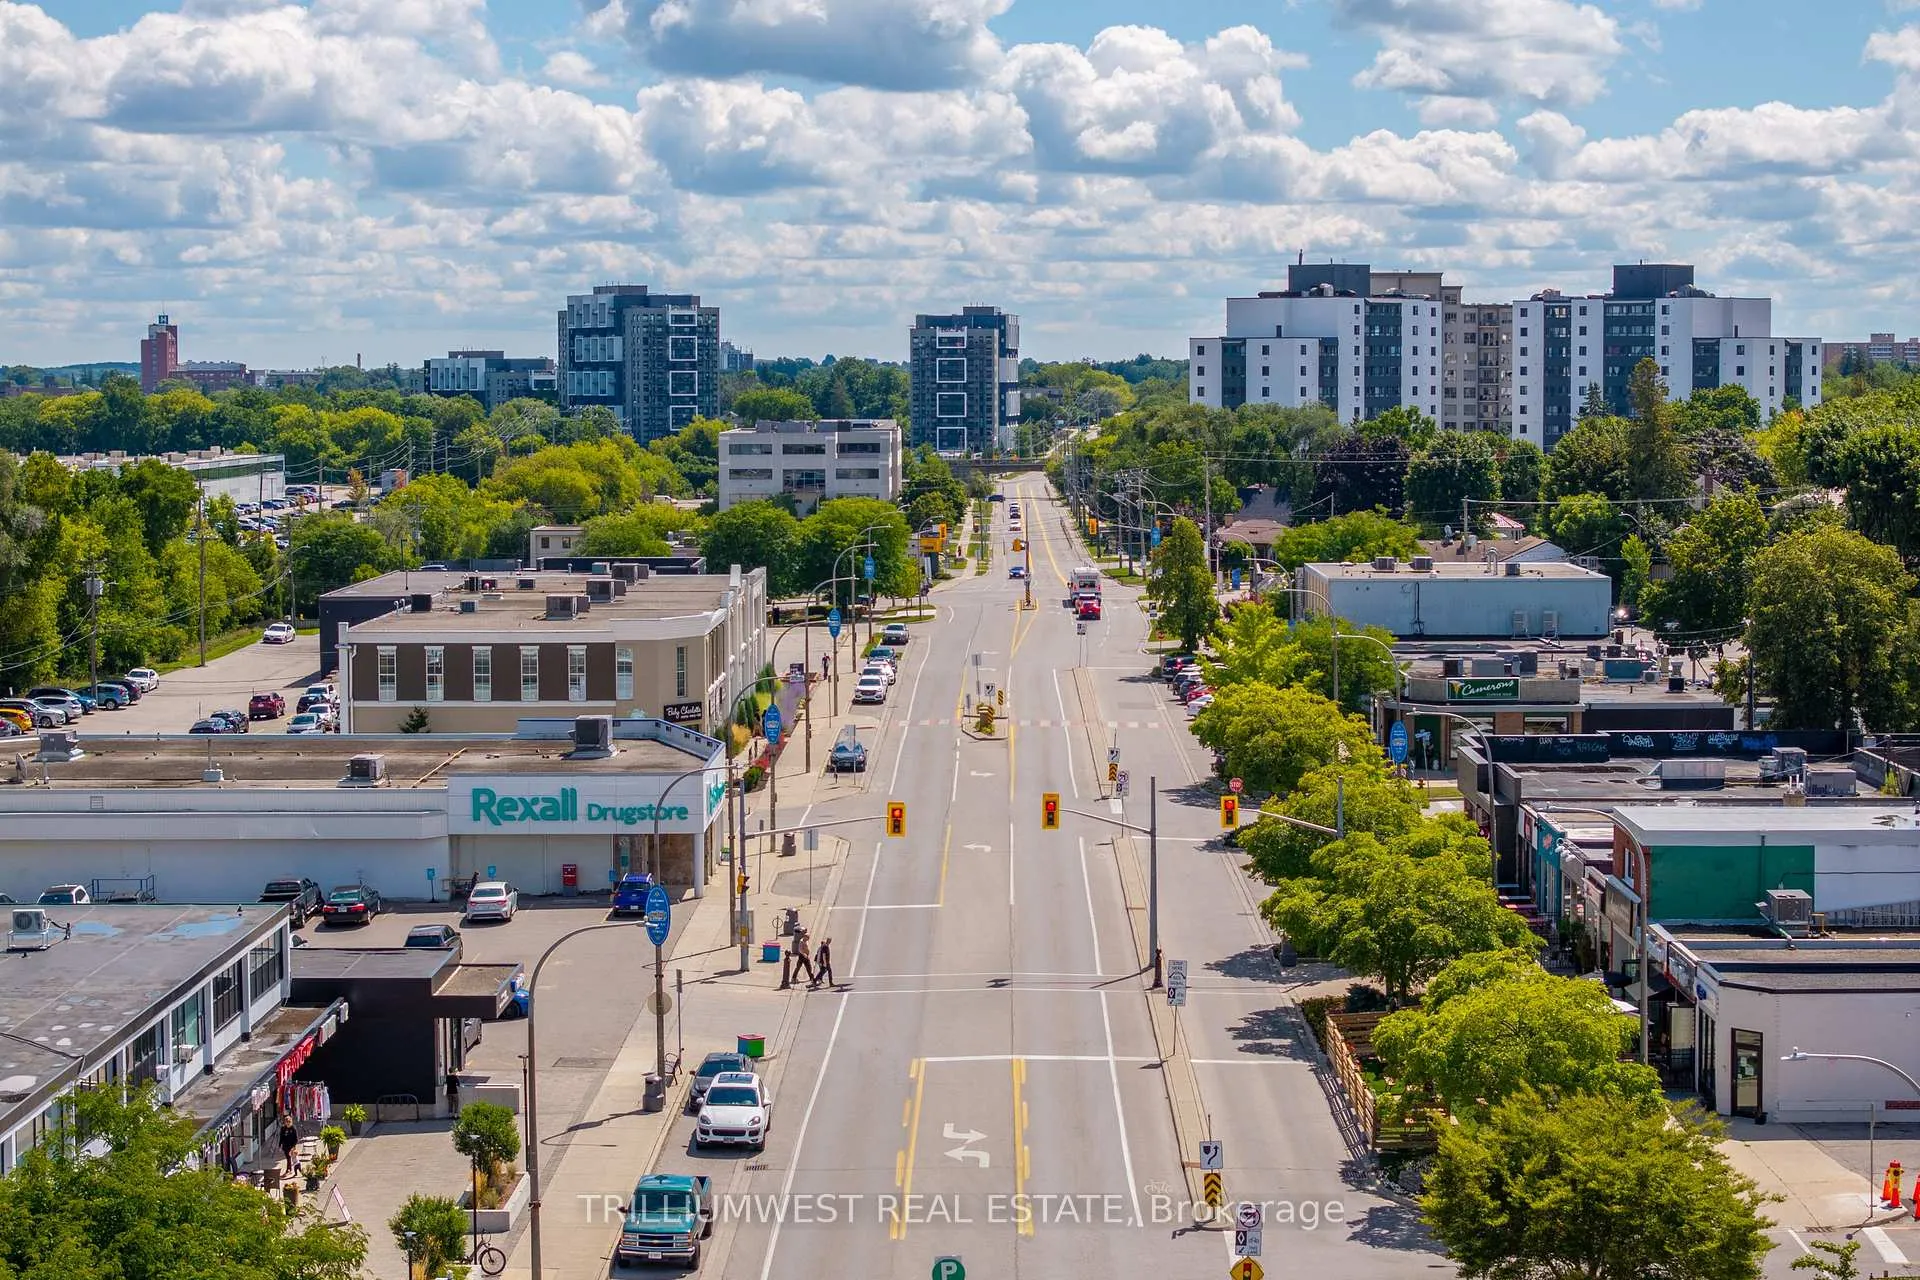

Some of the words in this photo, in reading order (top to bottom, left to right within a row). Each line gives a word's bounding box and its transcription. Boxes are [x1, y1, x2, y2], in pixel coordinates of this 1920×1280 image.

[1461, 680, 1514, 696] Camerons
[471, 787, 578, 826] Rexall
[586, 803, 689, 825] Drugstore
[940, 1262, 958, 1280] P
